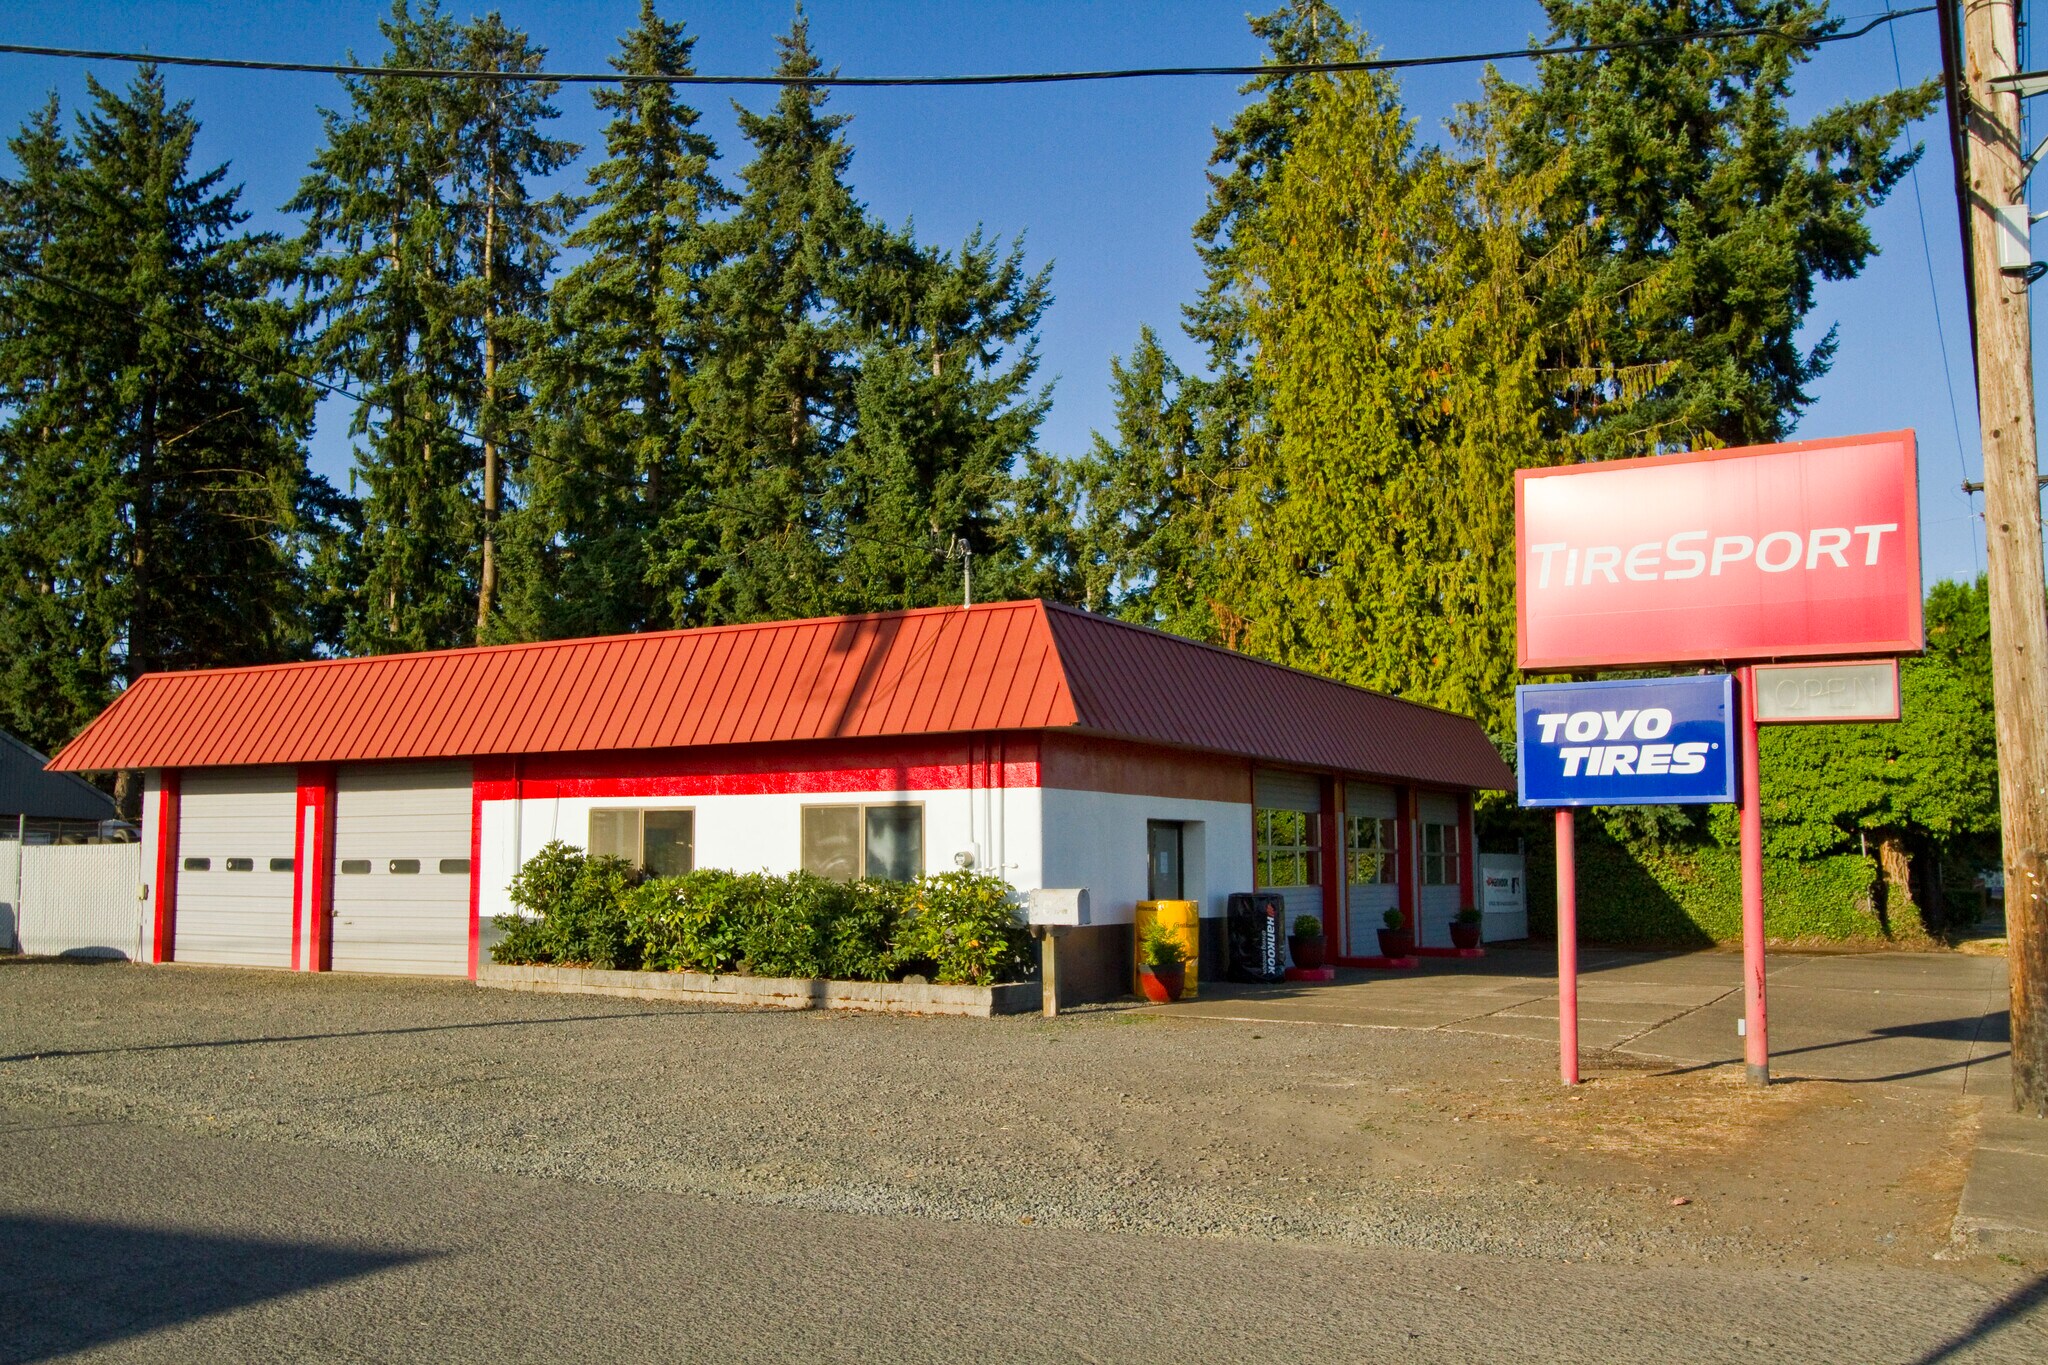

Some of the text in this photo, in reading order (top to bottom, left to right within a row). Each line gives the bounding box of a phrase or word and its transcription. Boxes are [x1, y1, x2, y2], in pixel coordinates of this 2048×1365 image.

[1531, 523, 1897, 589] TIRESPORT
[1776, 677, 1876, 708] OPEN
[1537, 708, 1672, 743] TOYO
[1559, 743, 1710, 777] TIRES
